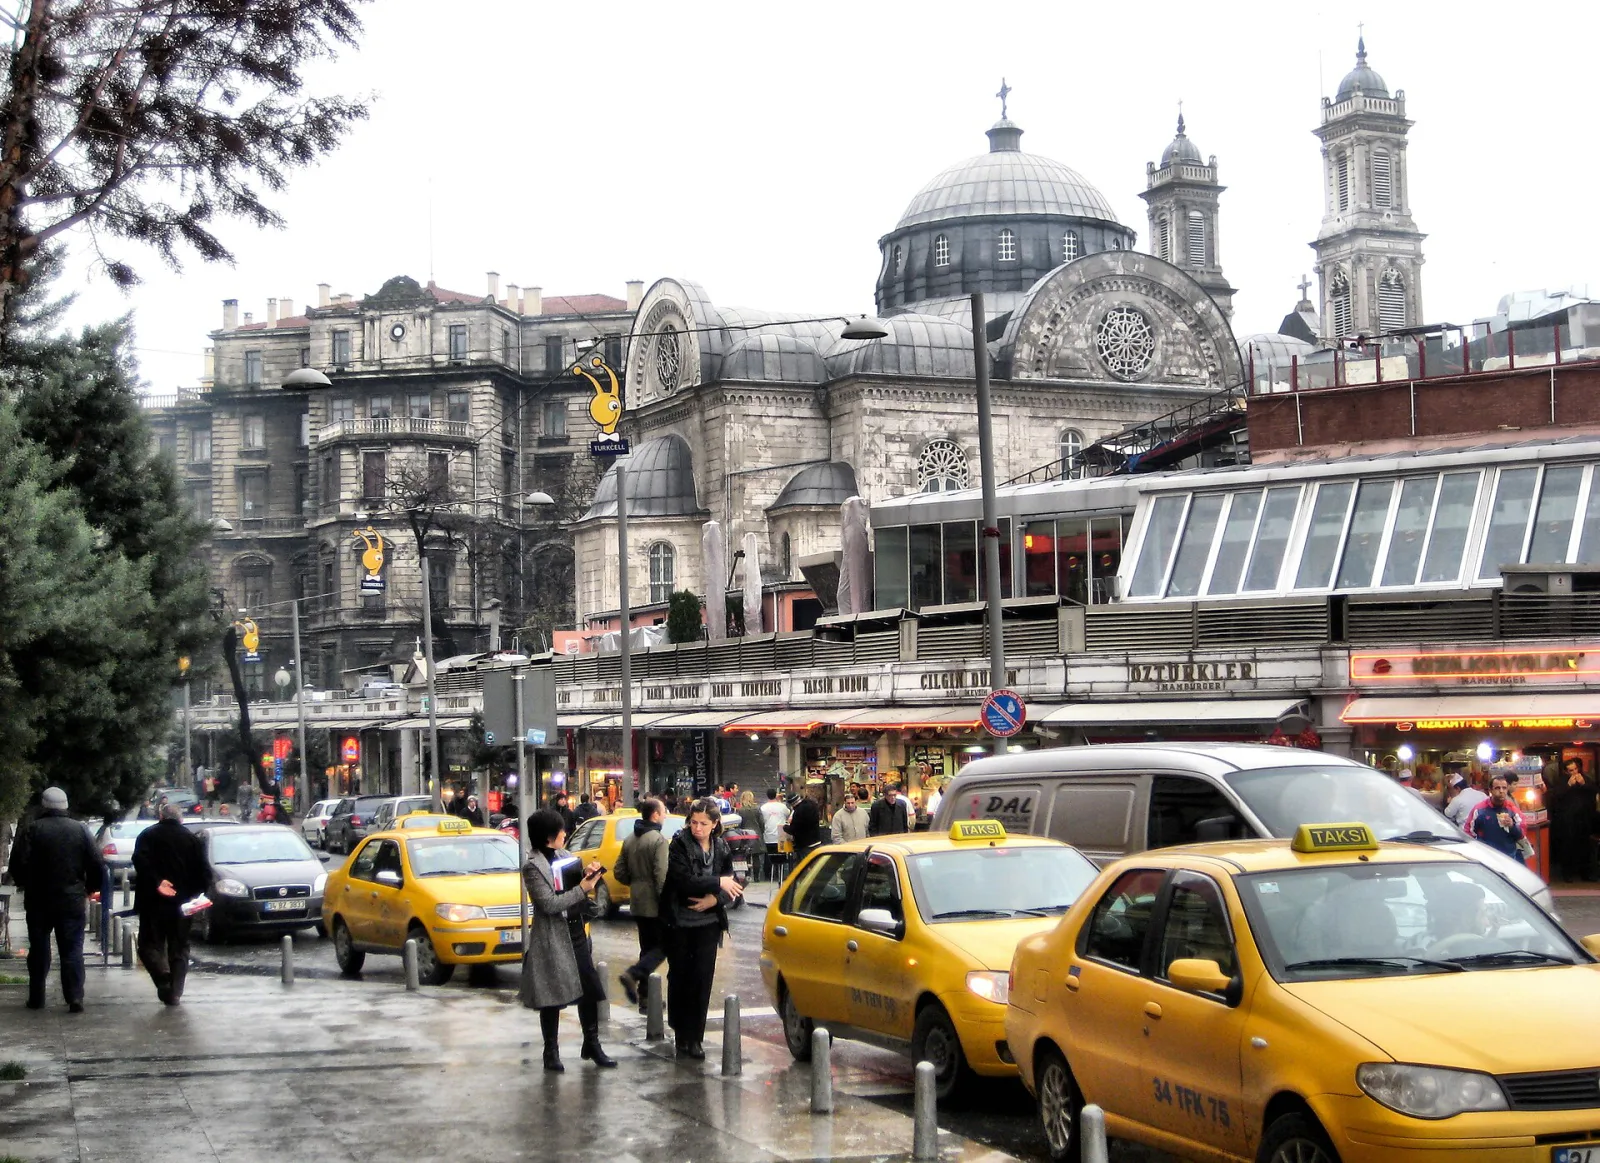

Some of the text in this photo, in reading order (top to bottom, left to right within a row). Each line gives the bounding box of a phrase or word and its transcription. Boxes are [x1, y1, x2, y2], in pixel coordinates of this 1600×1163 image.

[594, 444, 626, 452] TURKCELL
[1161, 682, 1222, 691] HAMBURGER
[1460, 676, 1527, 685] HAMBURGER
[712, 683, 733, 698] BAMBI
[694, 731, 707, 792] TURKCELL
[986, 796, 1032, 813] DAL
[1153, 1076, 1231, 1129] 34 TFK 75
